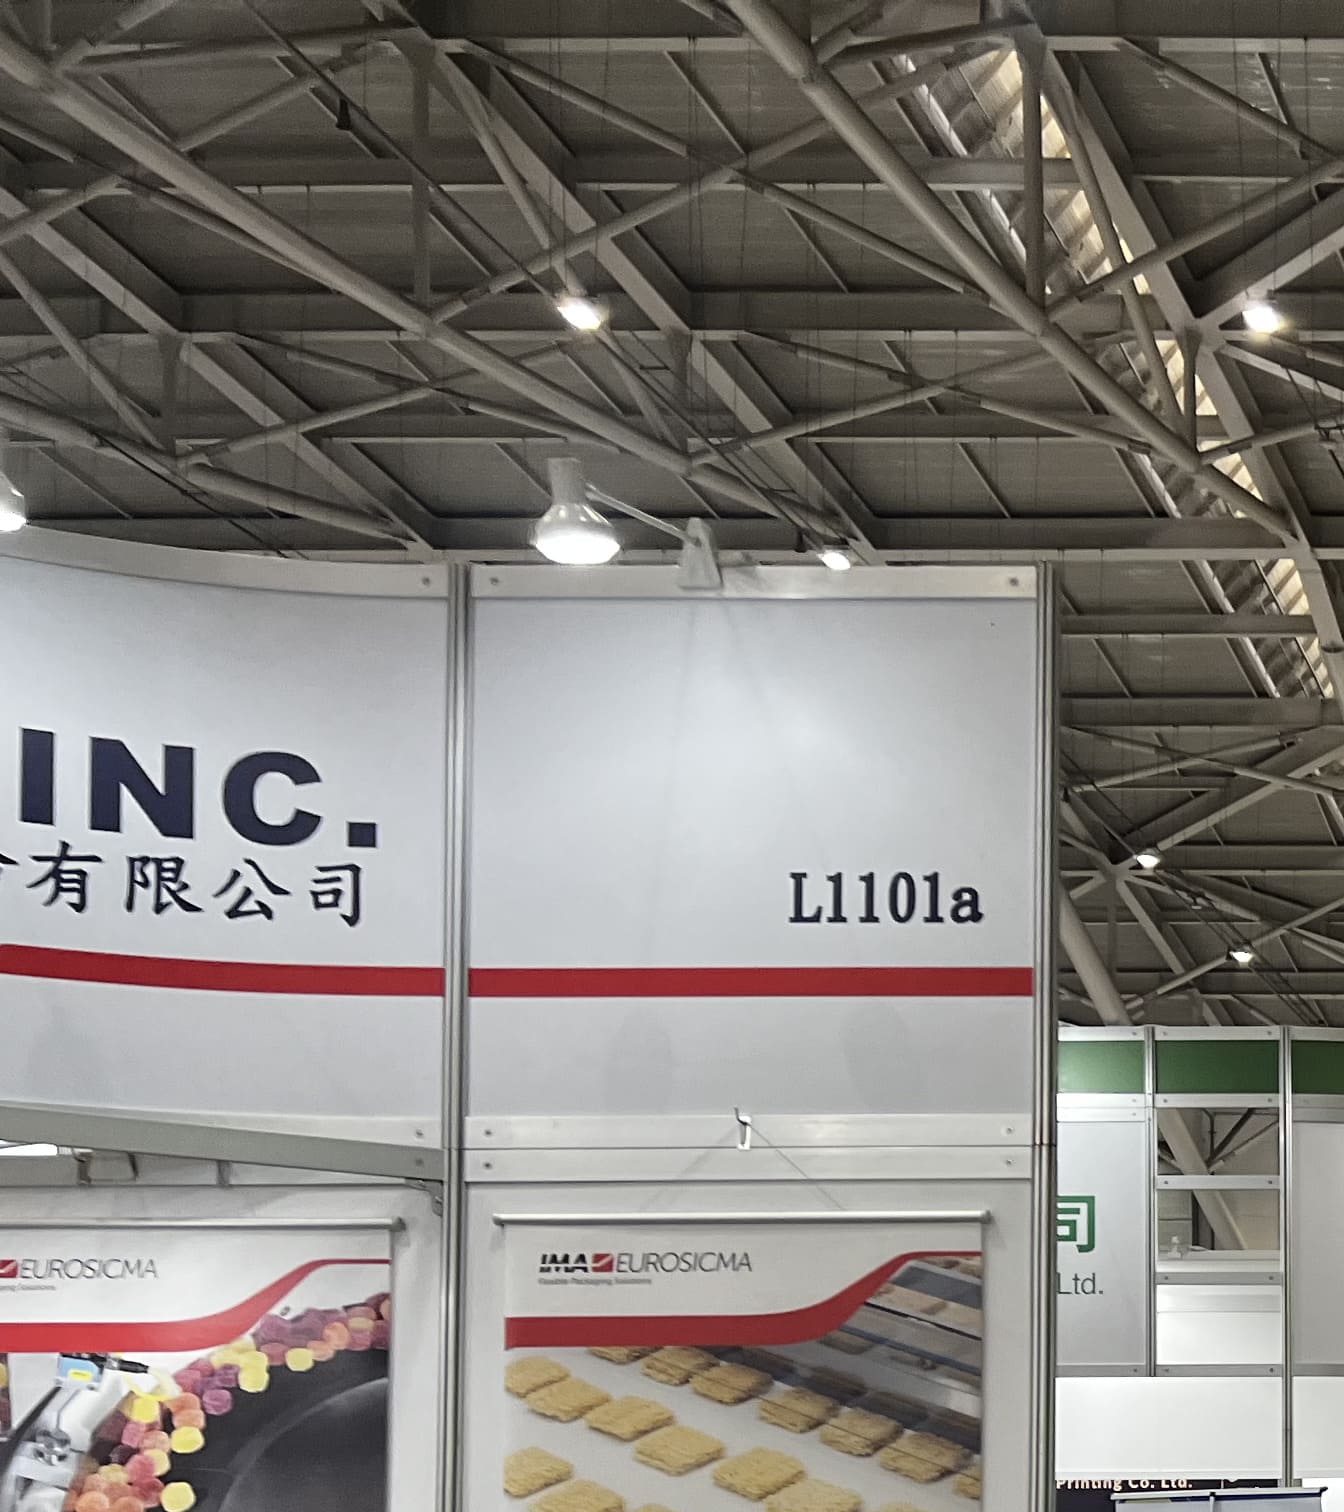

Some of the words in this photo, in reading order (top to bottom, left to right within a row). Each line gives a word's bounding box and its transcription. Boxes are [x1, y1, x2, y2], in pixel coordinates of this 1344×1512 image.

[20, 727, 378, 848] INC.
[0, 840, 363, 927] 有限公司
[788, 871, 983, 925] L1101a
[20, 1258, 158, 1279] EUROSICMA
[539, 1253, 589, 1273] IMA
[616, 1252, 753, 1273] EUROSICMA
[1057, 1273, 1104, 1294] Ltd.
